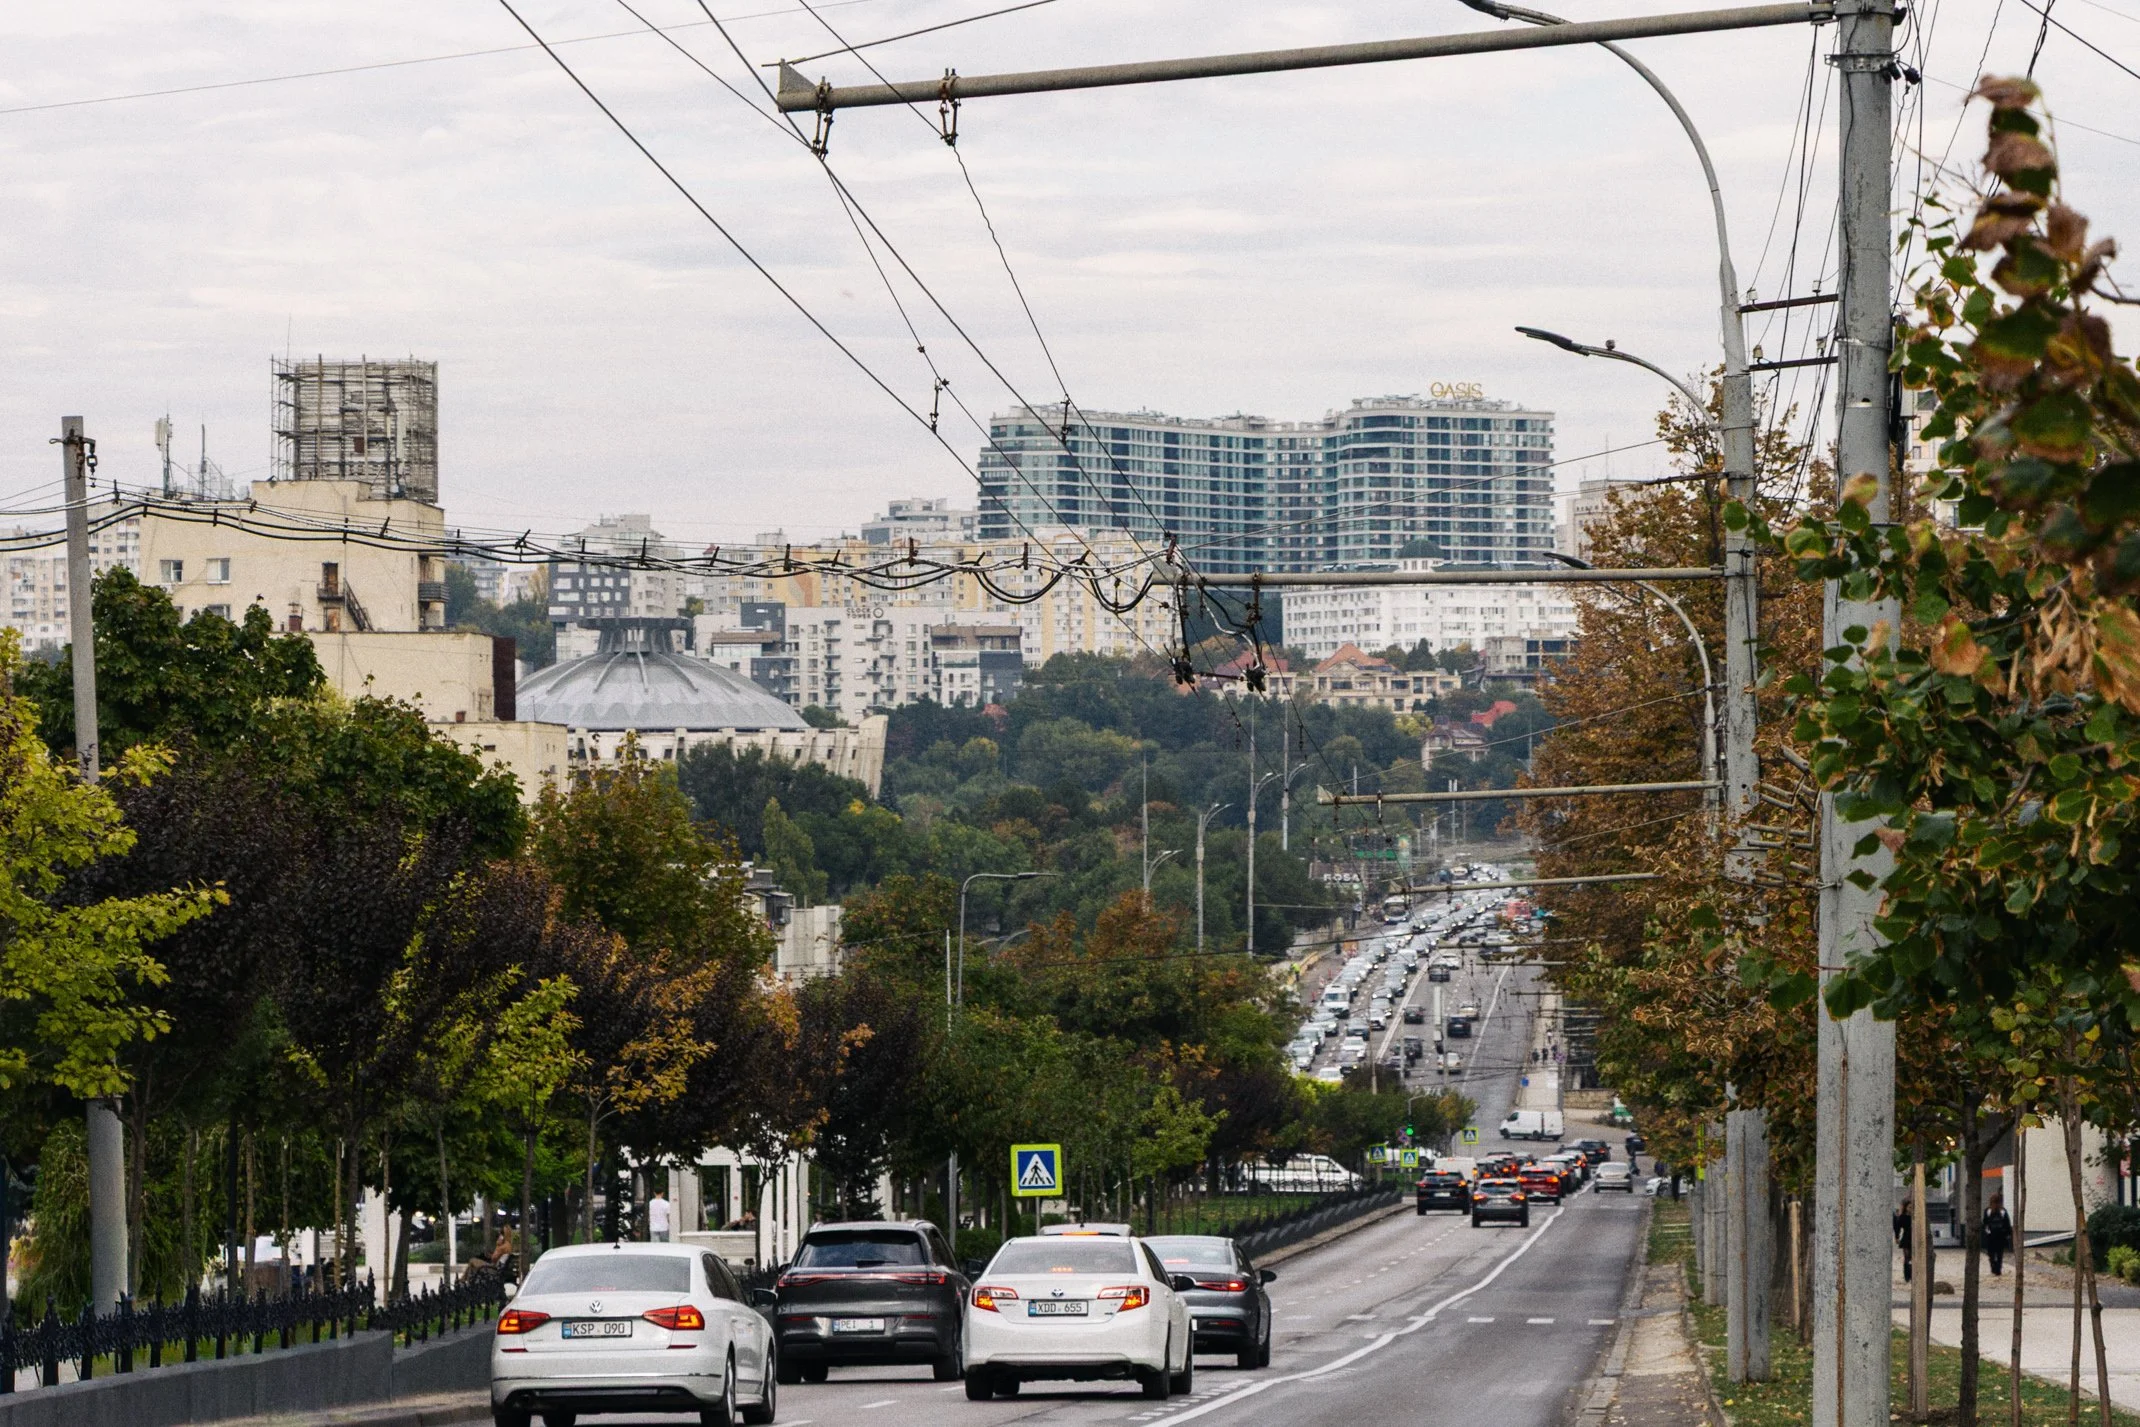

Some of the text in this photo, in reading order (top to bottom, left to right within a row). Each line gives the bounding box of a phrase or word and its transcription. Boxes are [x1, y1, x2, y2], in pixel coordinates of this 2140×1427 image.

[1430, 381, 1484, 399] OASIS
[1037, 1303, 1057, 1313] XDD
[1064, 1302, 1082, 1313] 655
[572, 1322, 595, 1335] KSP
[604, 1322, 625, 1334] 090
